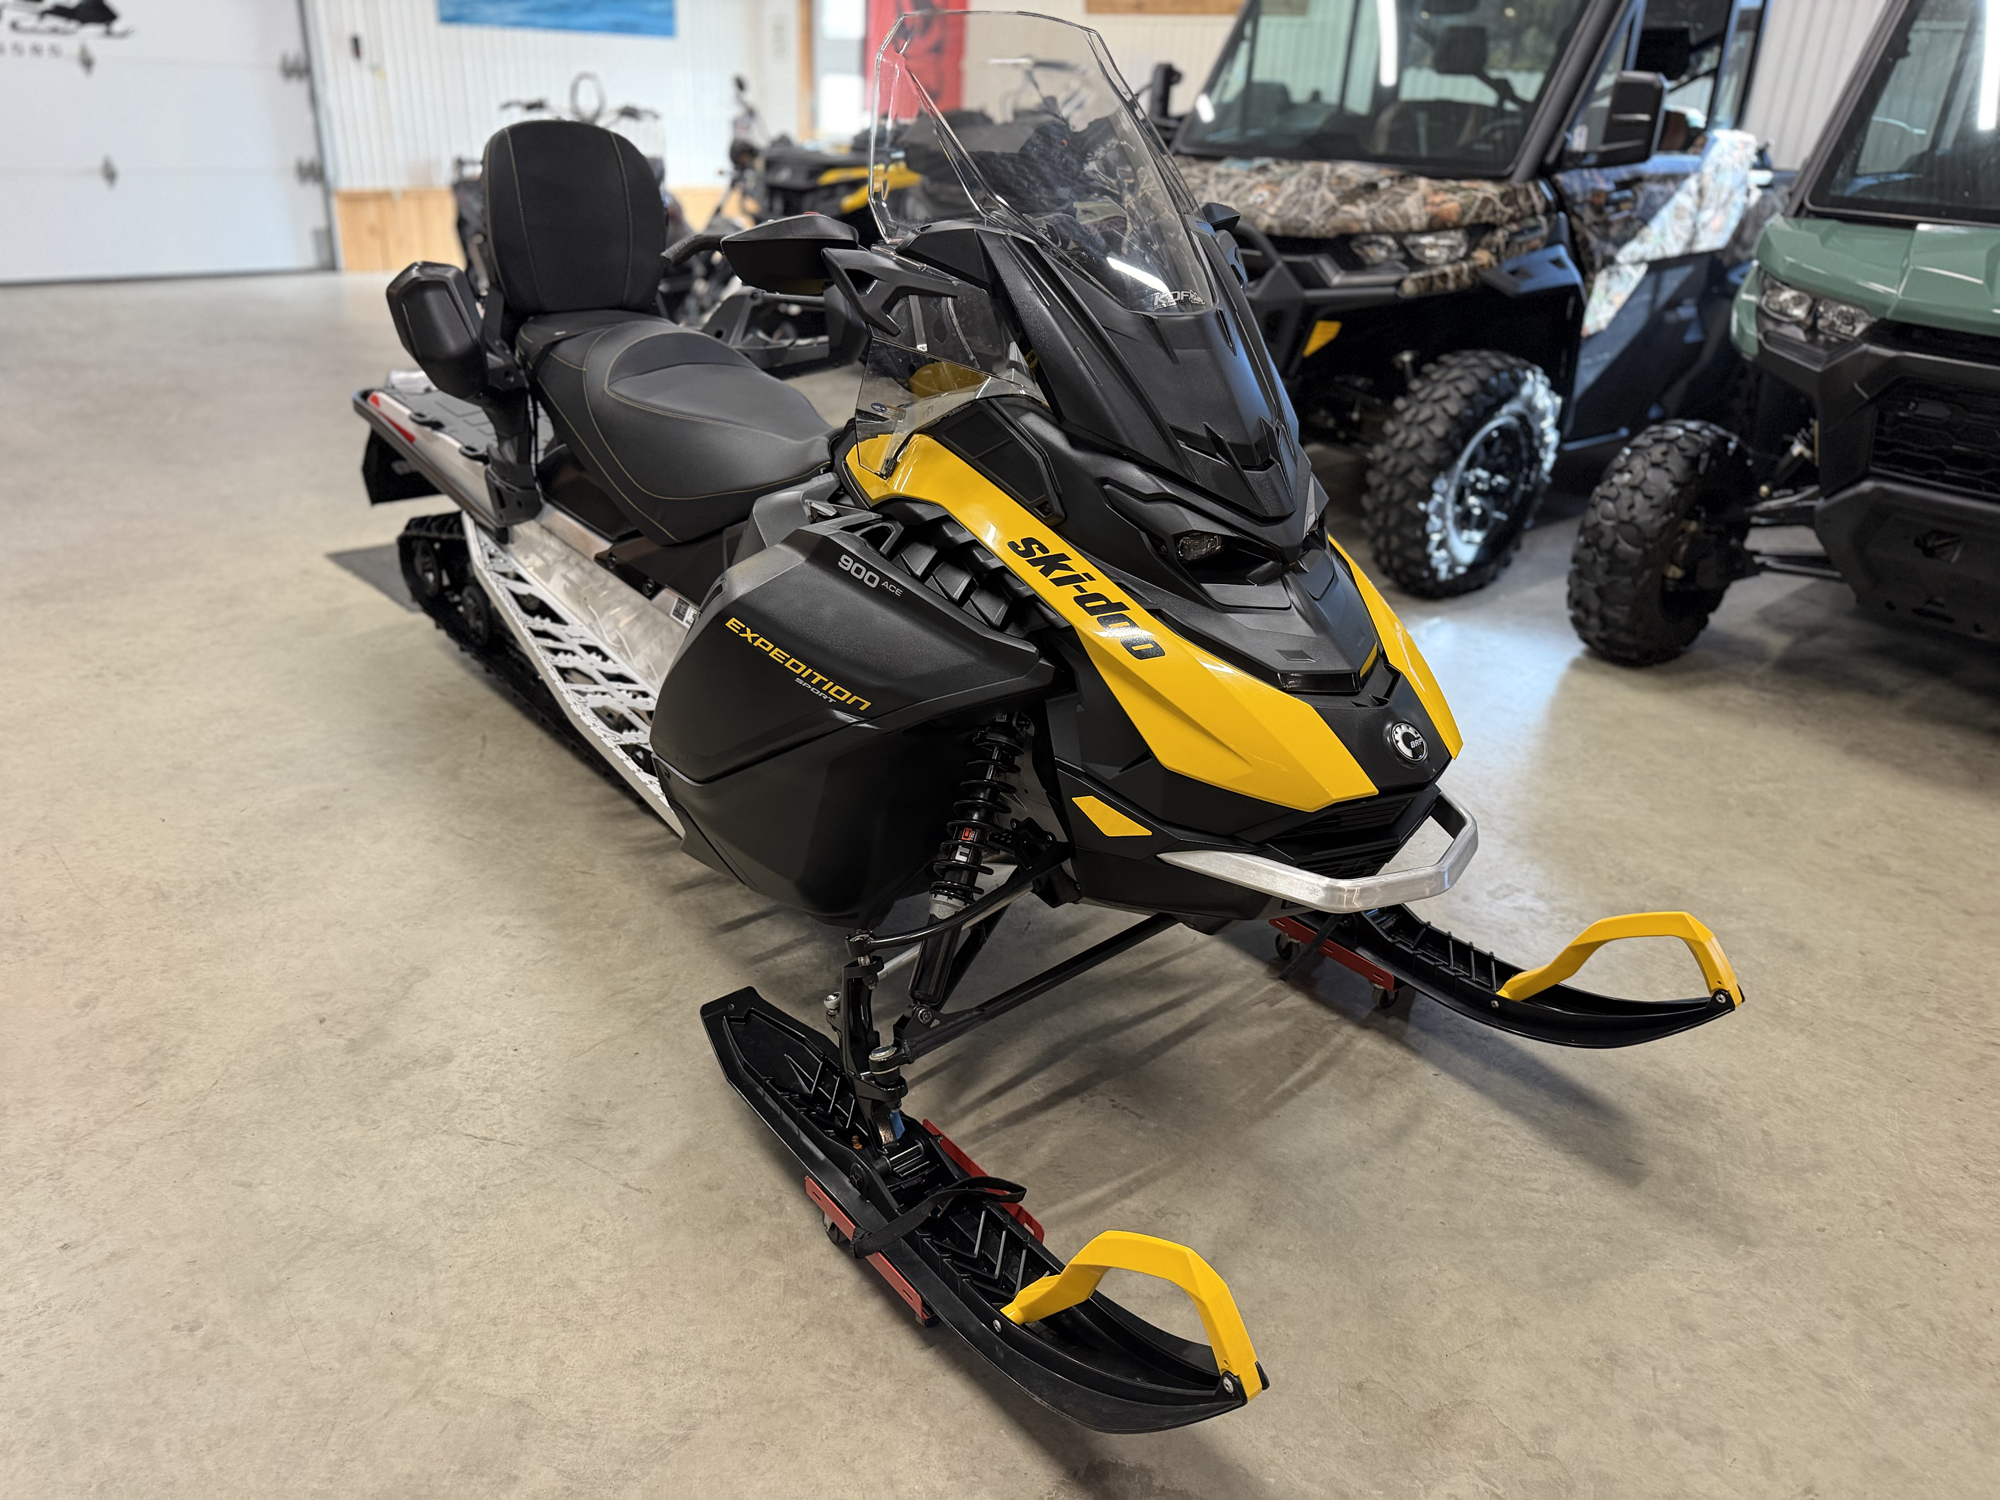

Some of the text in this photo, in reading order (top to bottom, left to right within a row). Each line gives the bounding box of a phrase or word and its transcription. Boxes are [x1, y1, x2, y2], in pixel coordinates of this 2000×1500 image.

[837, 554, 903, 597] 900 ACE
[1007, 537, 1166, 660] ski-doo
[725, 617, 872, 711] EXPEDITION
[794, 677, 837, 703] SPORT
